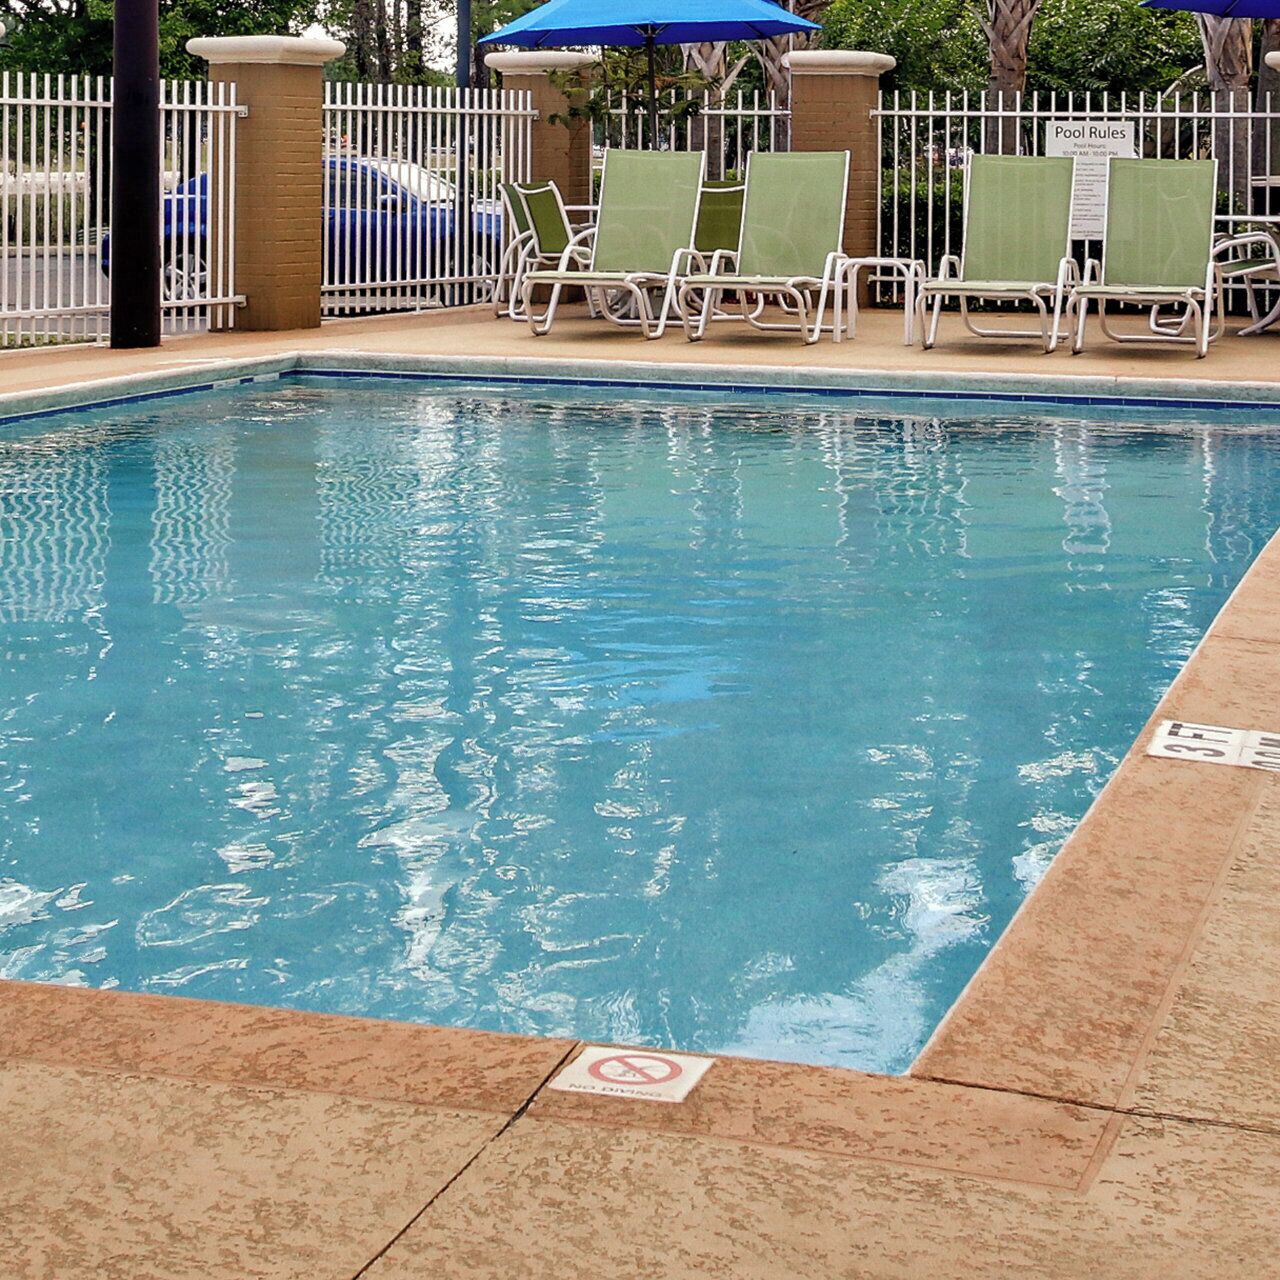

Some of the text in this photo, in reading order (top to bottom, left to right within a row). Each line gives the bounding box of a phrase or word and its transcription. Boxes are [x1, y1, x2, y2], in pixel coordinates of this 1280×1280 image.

[1055, 126, 1126, 139] Pool Rules
[1163, 723, 1232, 757] 3 FT
[602, 1086, 662, 1097] DIVING
